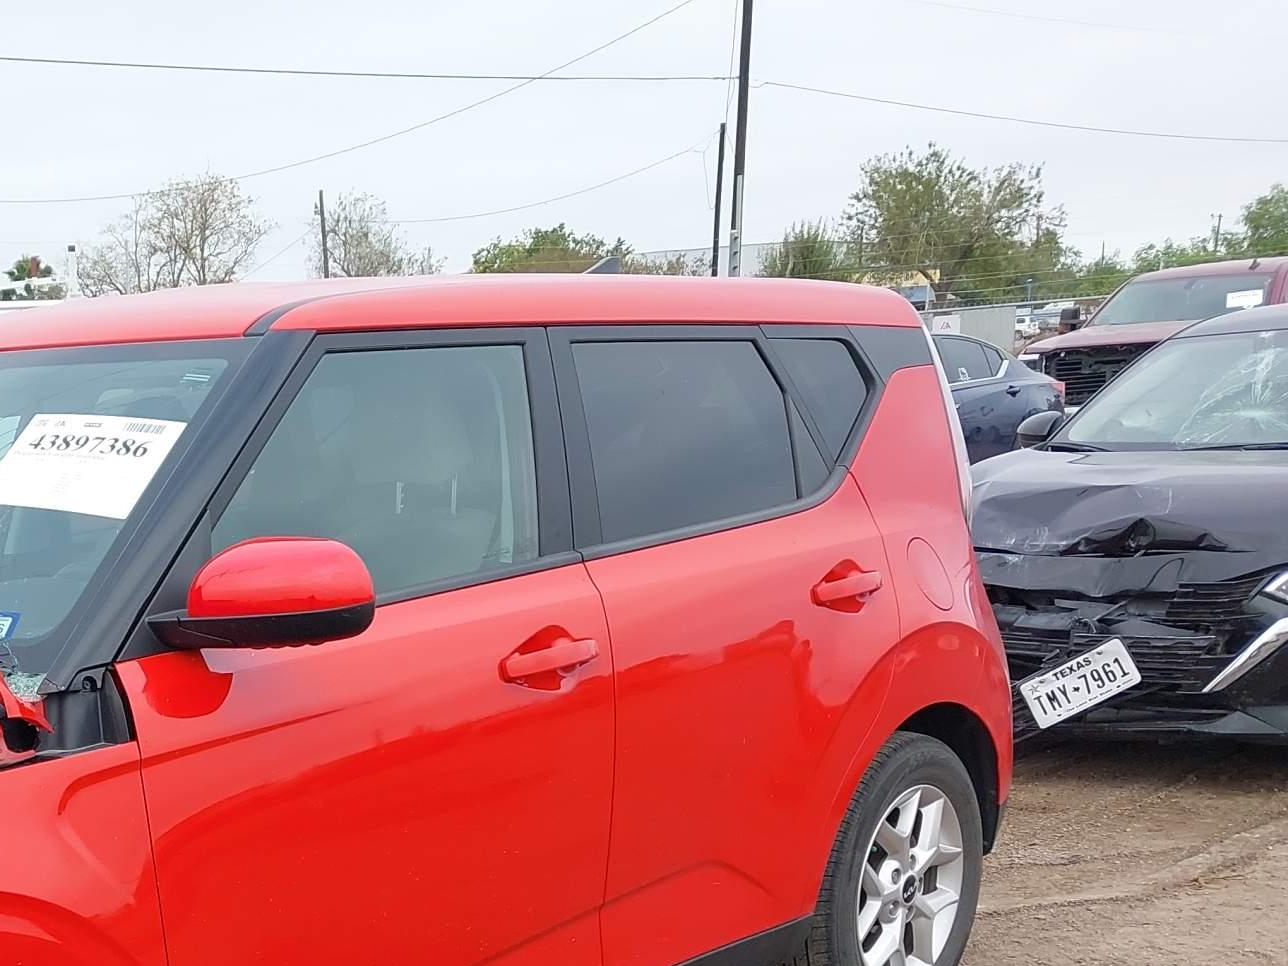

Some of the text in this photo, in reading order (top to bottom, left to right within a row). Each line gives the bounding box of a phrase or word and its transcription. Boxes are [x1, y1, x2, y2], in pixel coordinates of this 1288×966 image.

[28, 433, 152, 458] 43897386
[1052, 657, 1092, 681] TEXAS
[1033, 684, 1071, 716] TMY
[1077, 657, 1130, 695] 7961
